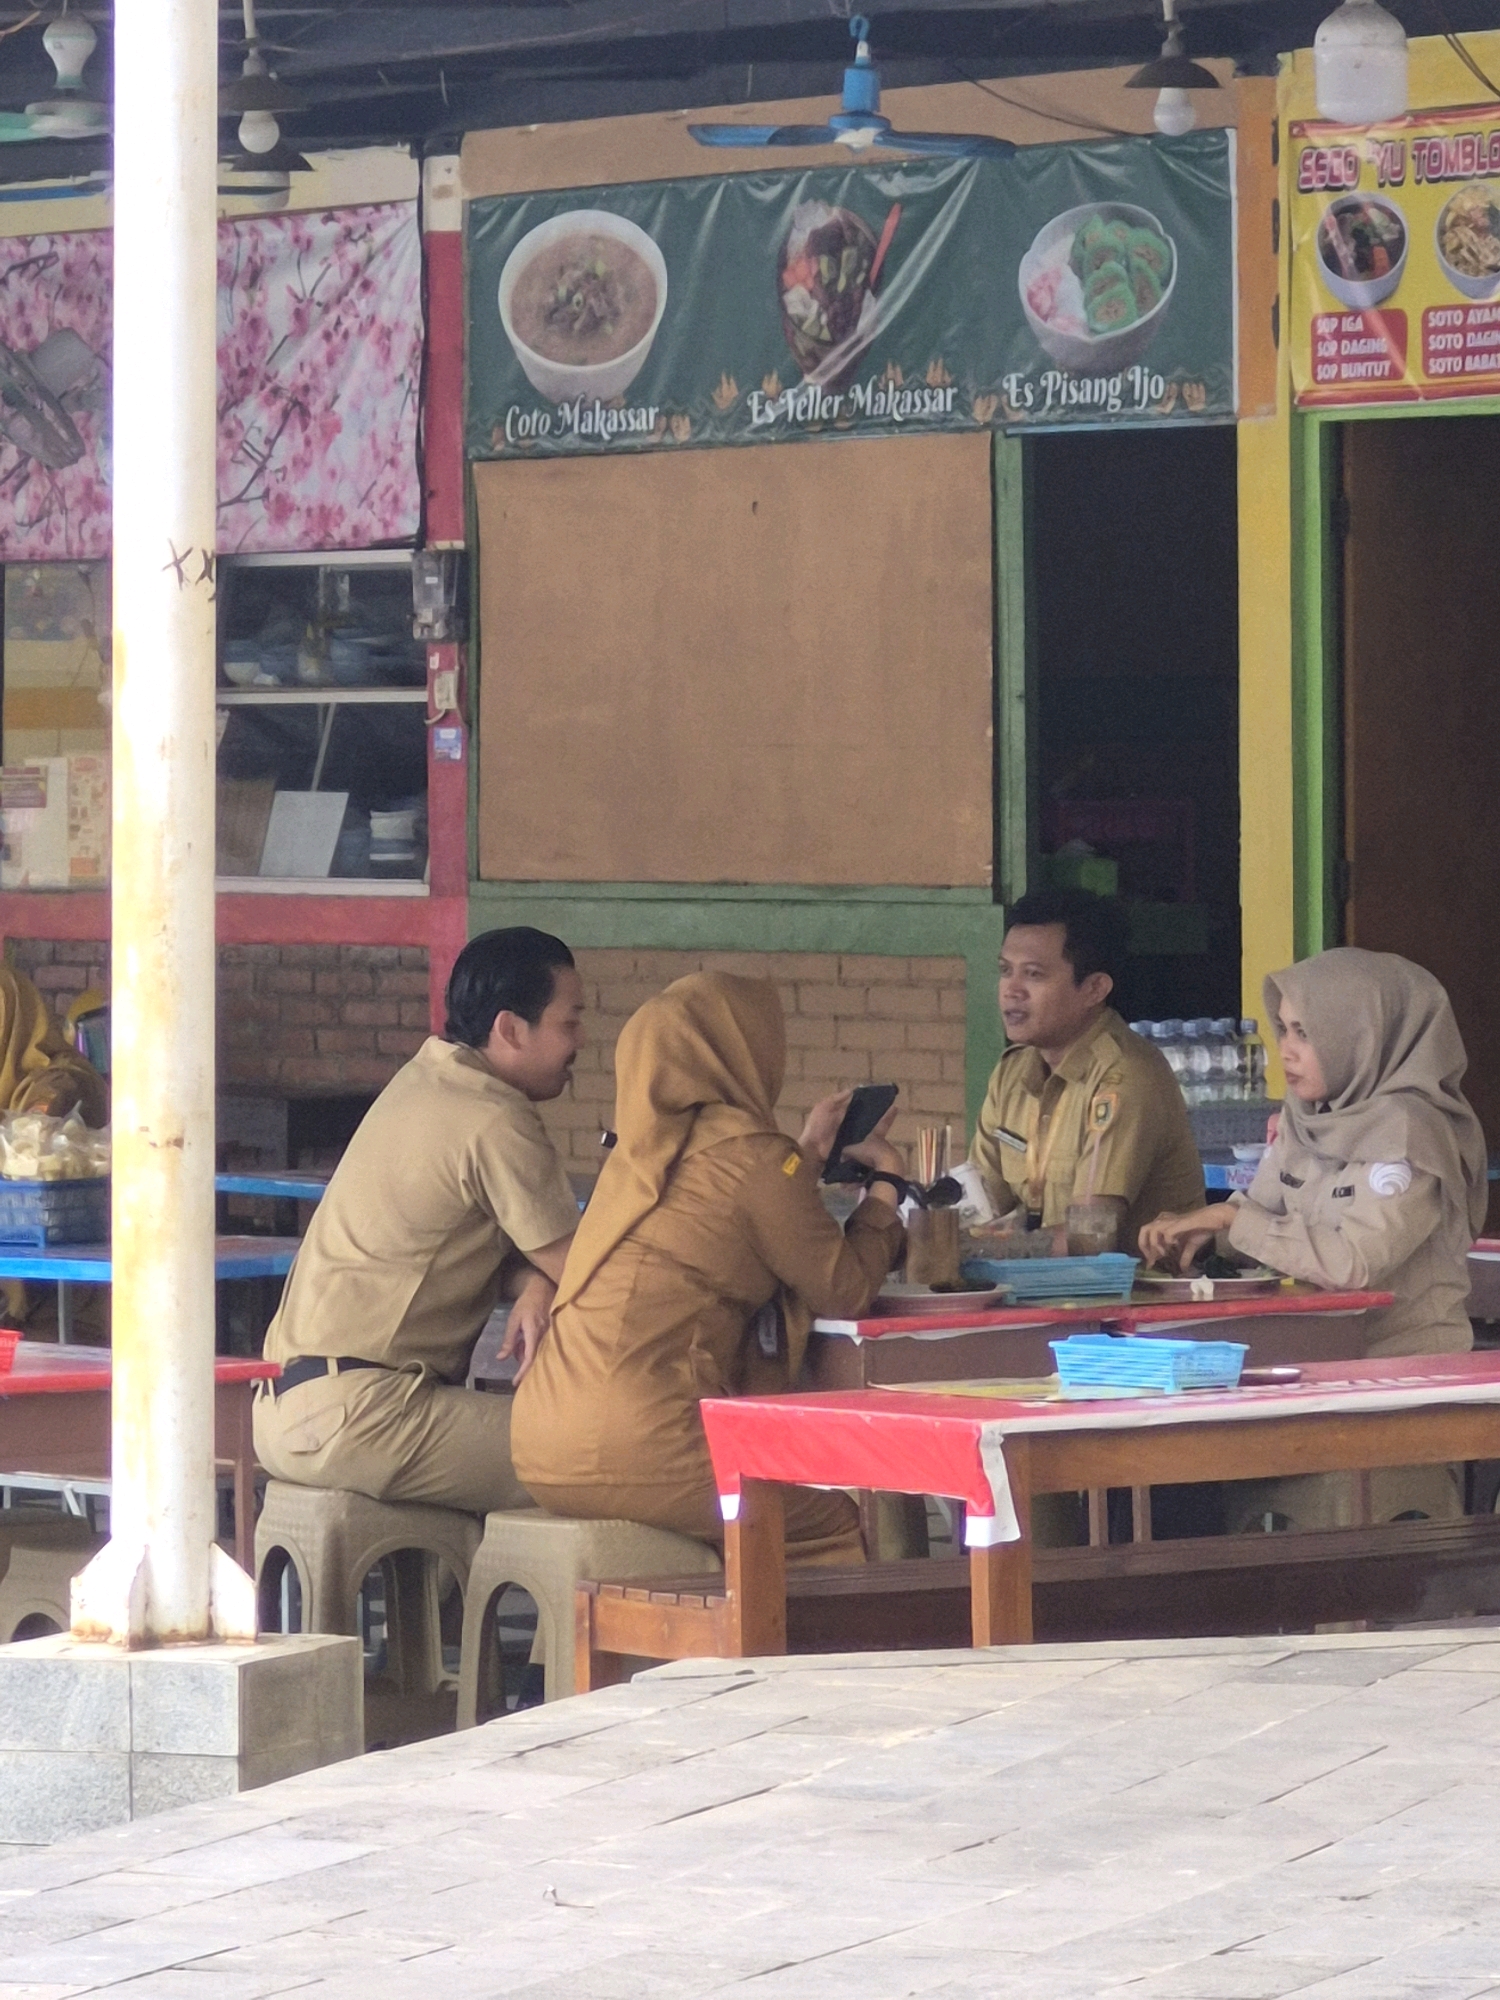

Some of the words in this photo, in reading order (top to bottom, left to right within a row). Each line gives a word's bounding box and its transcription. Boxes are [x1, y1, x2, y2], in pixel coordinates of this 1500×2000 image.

[1366, 138, 1406, 188] YU
[1317, 317, 1338, 335] SOP
[1341, 314, 1364, 332] IGA
[1428, 310, 1464, 327] SOTO
[1317, 340, 1338, 357] SOP
[1341, 338, 1388, 355] DAGING
[1428, 333, 1464, 351] SOTO
[1317, 363, 1338, 381] SOP
[1341, 360, 1391, 379] BUNTUT
[1428, 356, 1463, 374] SOTO
[1002, 373, 1034, 408] Es
[1039, 370, 1123, 413] Pisang
[1127, 364, 1165, 410] Ijo
[747, 390, 776, 424] Es
[779, 384, 845, 423] Teller
[848, 375, 958, 422] Makassar
[504, 405, 550, 442] Coto
[554, 393, 660, 441] Makassar
